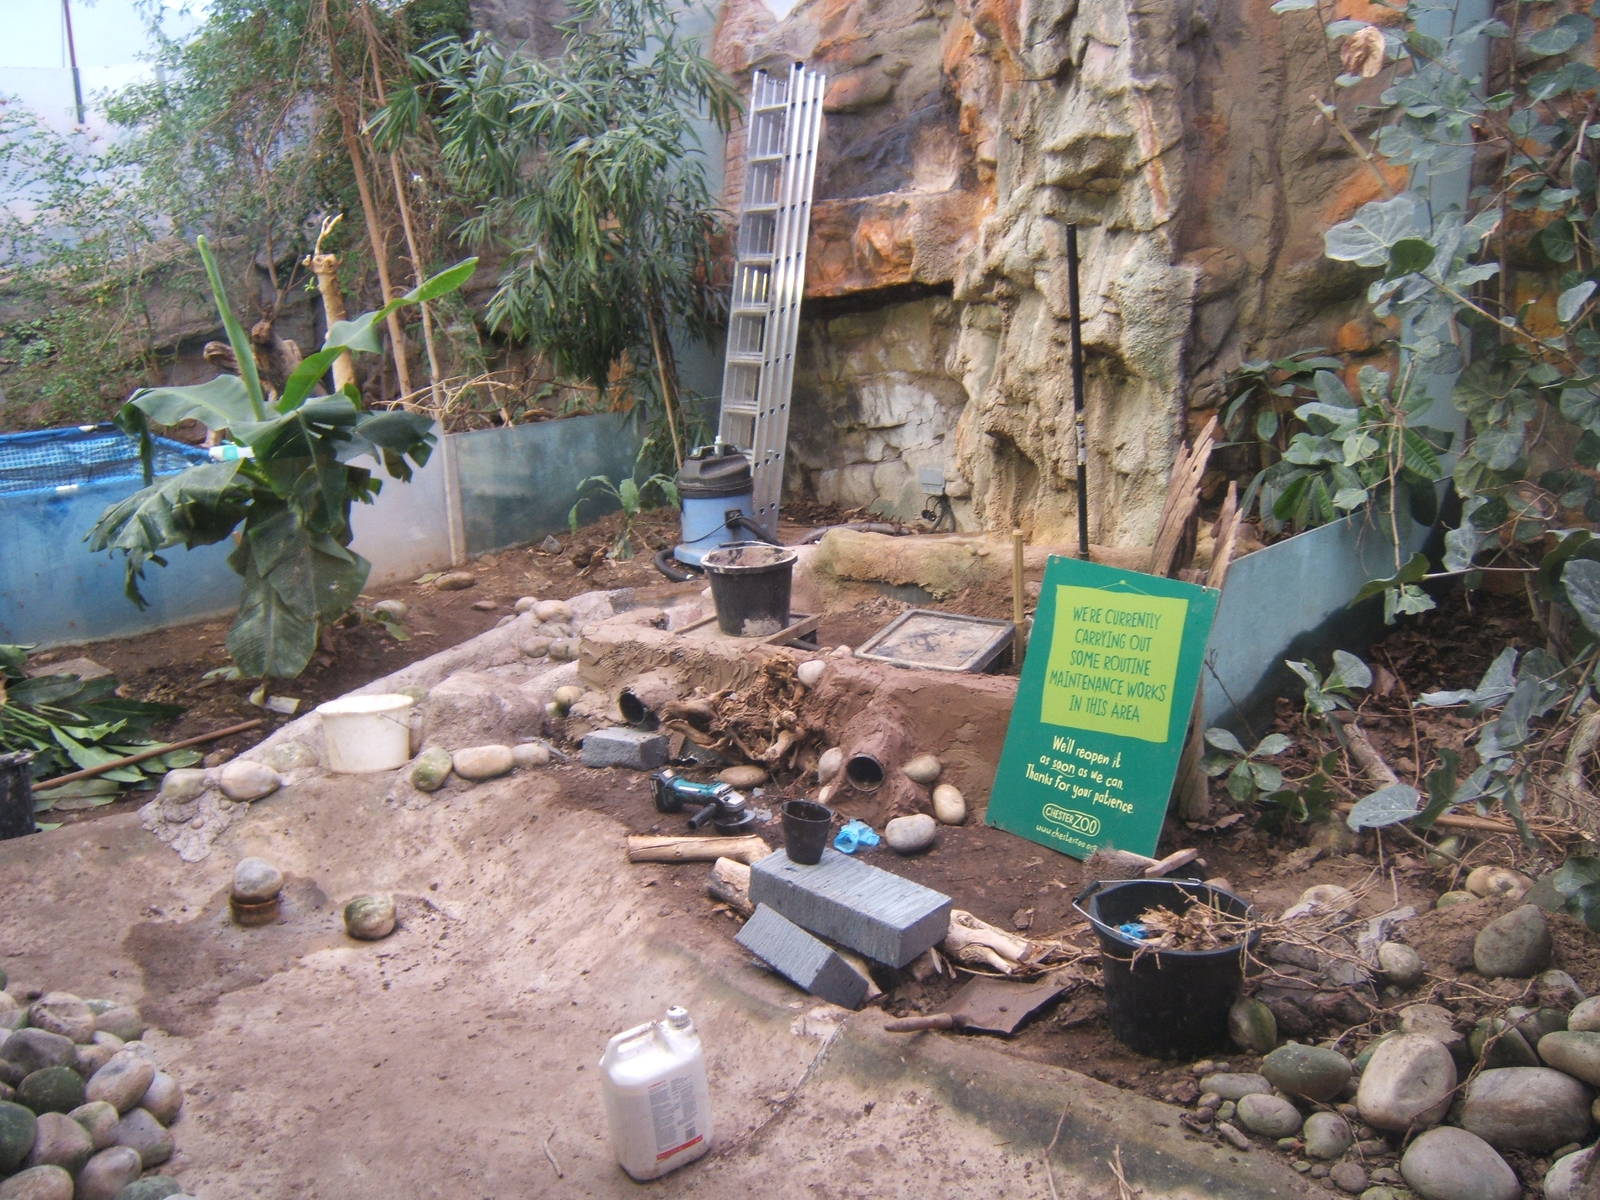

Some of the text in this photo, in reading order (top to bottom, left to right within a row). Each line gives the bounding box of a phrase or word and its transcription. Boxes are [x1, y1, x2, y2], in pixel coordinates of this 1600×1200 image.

[1105, 609, 1162, 630] CURRENTLY
[1075, 628, 1152, 652] CARRYING OUT
[1070, 650, 1151, 676] SOME ROUTINE
[1049, 670, 1166, 702] MAINTENANCE WORKS
[1069, 695, 1140, 722] IN THIS AREA
[1052, 736, 1121, 768] We'll reopen it
[1026, 764, 1053, 786] Thanks
[1054, 776, 1070, 792] for
[1072, 785, 1093, 798] your
[1040, 755, 1050, 765] as
[1052, 760, 1076, 774] soon
[1078, 767, 1088, 778] as
[1090, 771, 1104, 783] we
